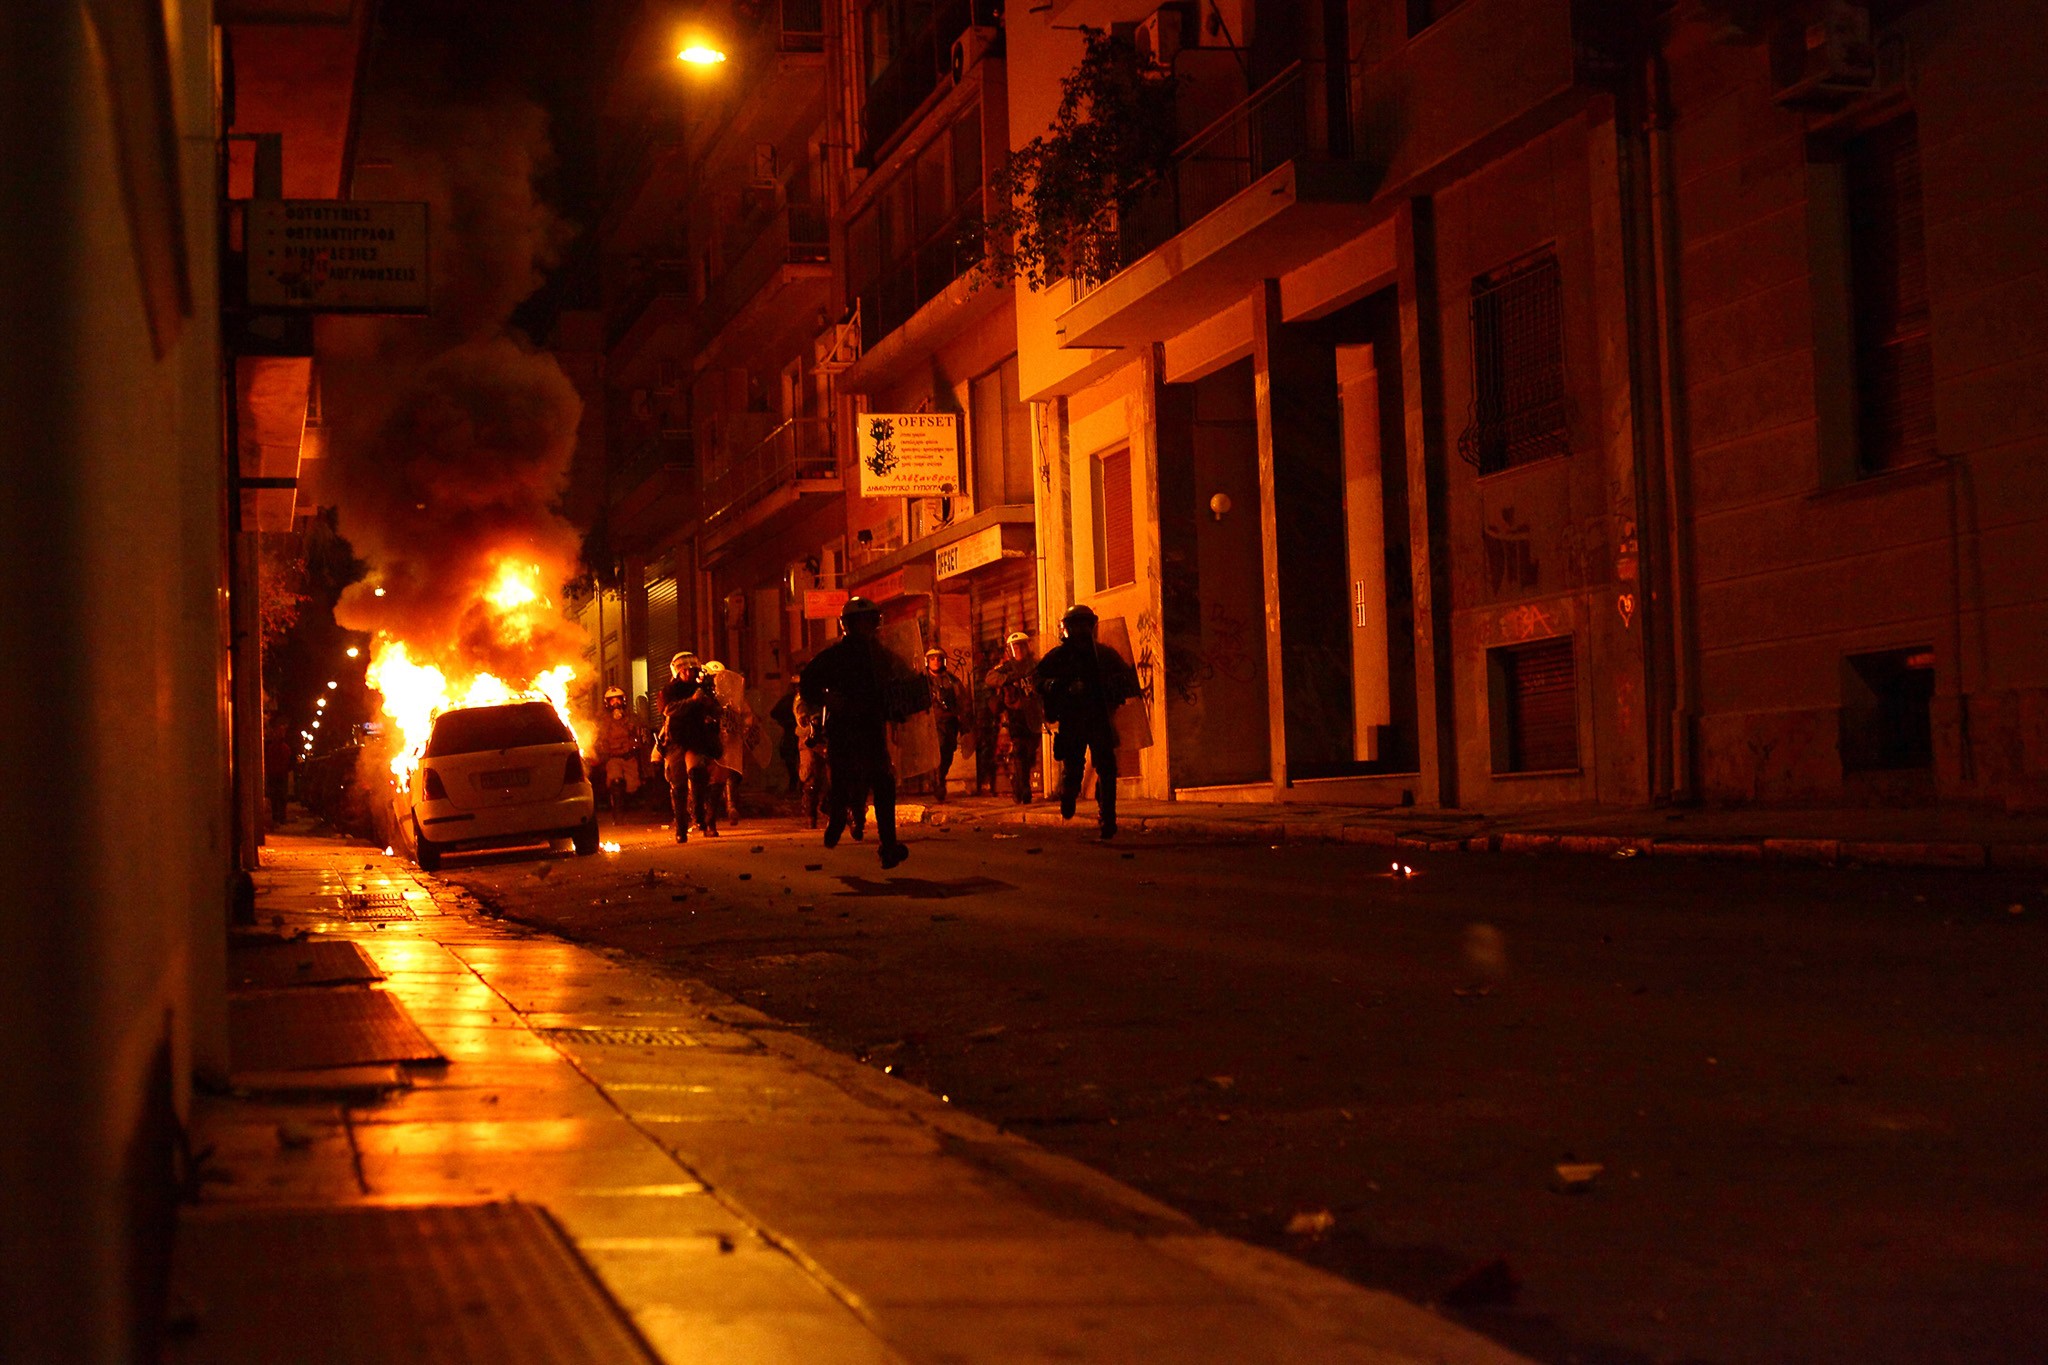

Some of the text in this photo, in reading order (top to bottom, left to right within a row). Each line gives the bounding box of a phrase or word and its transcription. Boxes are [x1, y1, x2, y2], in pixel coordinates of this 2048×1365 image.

[285, 227, 395, 241] ΦΩΤΟΑΝΤΙΓΡΑΦΑ
[898, 416, 954, 427] OFFSET
[913, 484, 958, 492] ΤΥΠΟΓΡΑΟ
[938, 547, 958, 576] OFFSET
